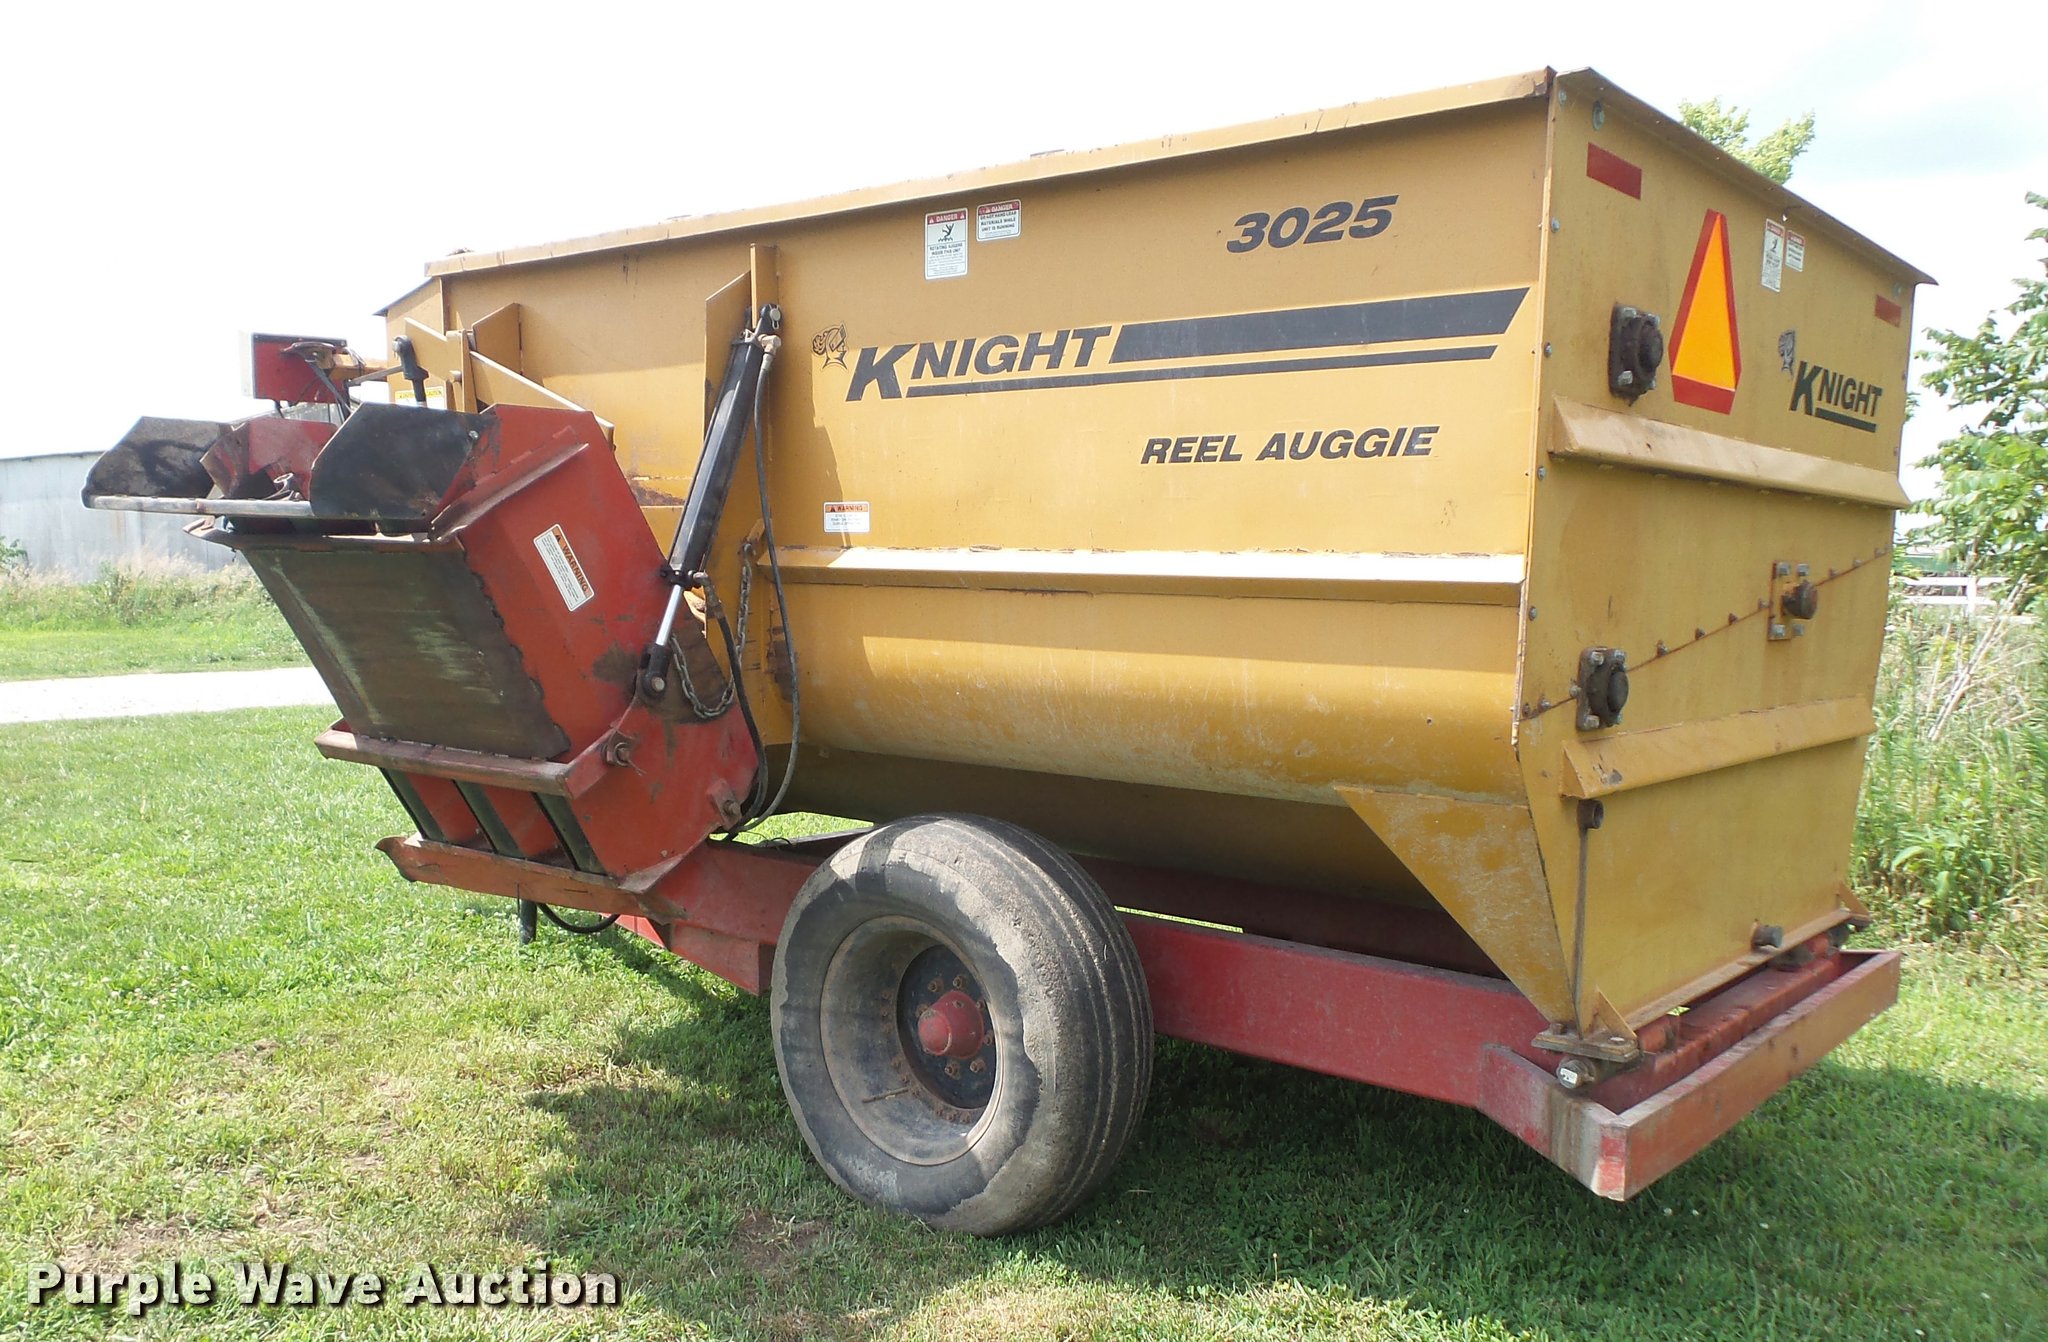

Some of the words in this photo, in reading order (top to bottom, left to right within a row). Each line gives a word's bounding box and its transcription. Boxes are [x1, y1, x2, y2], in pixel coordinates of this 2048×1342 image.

[936, 213, 957, 222] DANGER
[991, 203, 1012, 212] DANGER
[1227, 194, 1399, 253] 3025
[845, 326, 1112, 402] KNIGHT
[1789, 360, 1883, 417] KNIGHT
[1140, 435, 1243, 465] REEL
[1255, 427, 1440, 461] AUGGIE
[563, 545, 589, 592] WARNING
